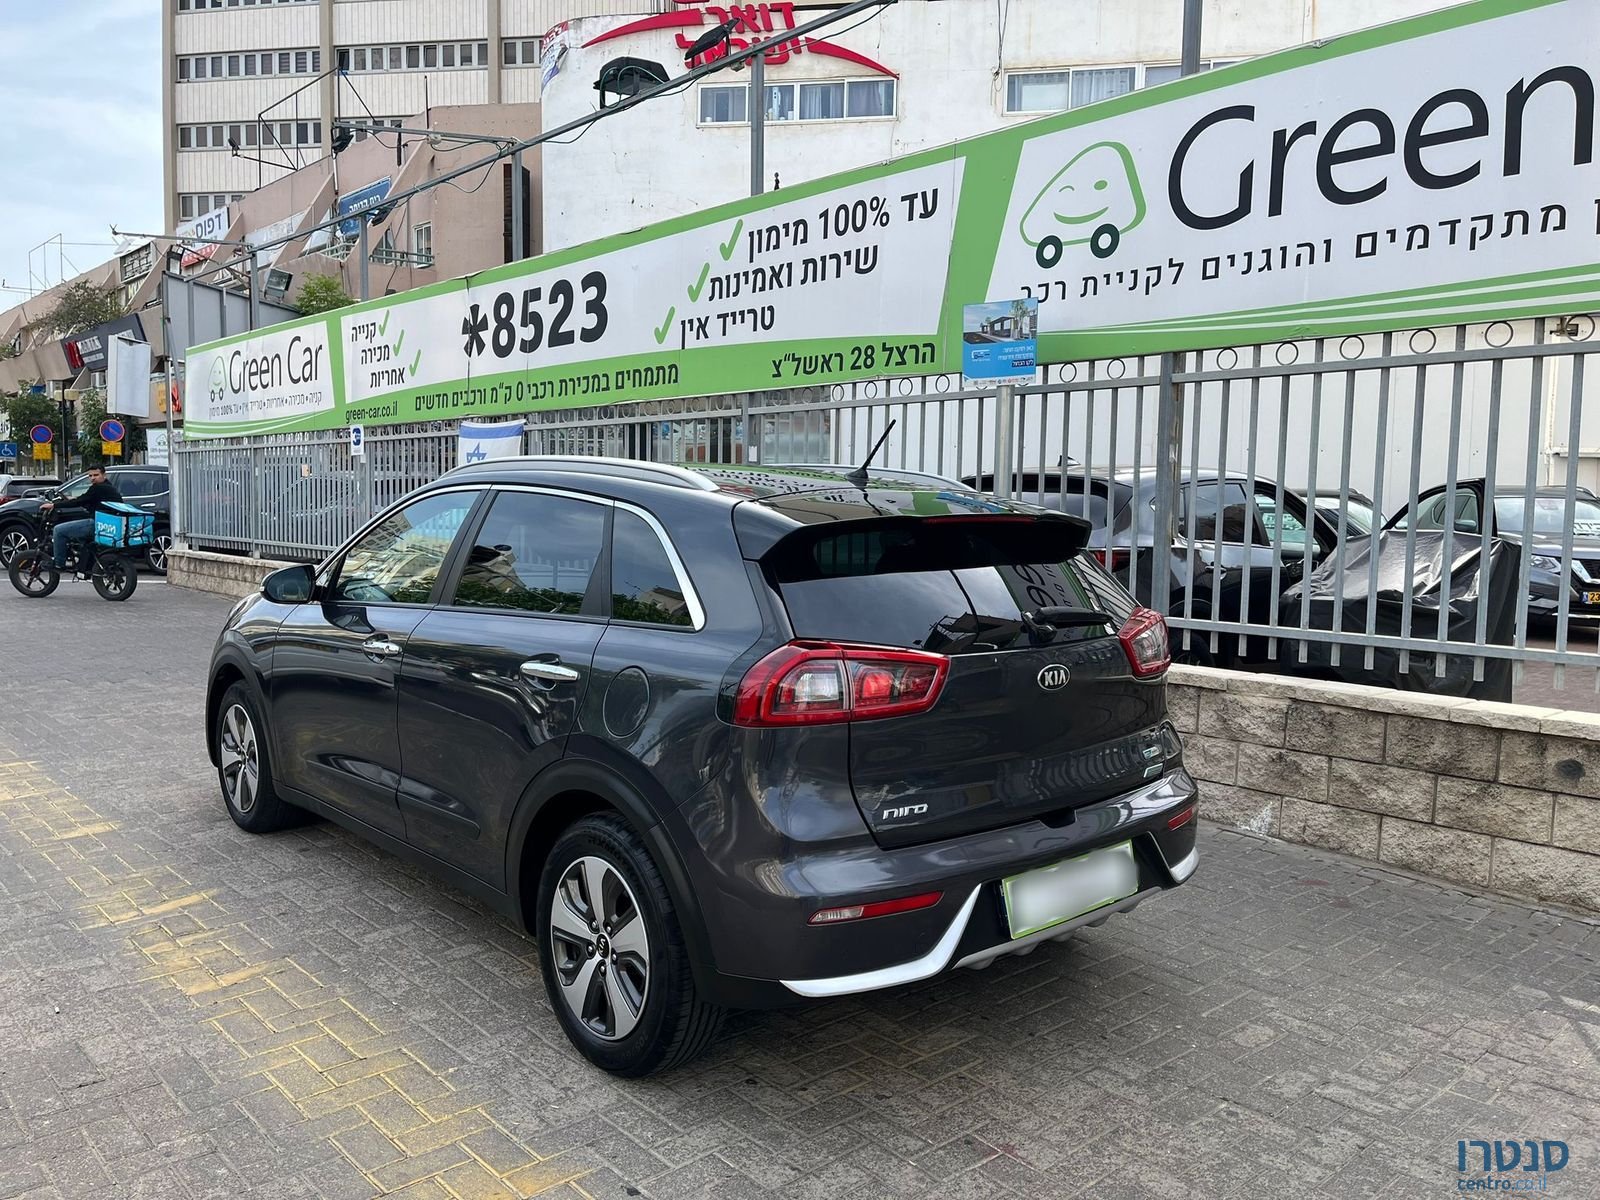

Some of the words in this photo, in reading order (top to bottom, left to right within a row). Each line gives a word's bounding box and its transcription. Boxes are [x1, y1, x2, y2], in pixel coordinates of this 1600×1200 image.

[705, 2, 795, 34] דואר
[1168, 65, 1595, 231] Green
[901, 188, 939, 221] עד
[195, 214, 222, 239] דפוס
[818, 196, 890, 240] 100%
[748, 218, 808, 263] מימון
[1355, 203, 1567, 259] מתקדמים
[800, 245, 879, 286] שירות
[1201, 237, 1332, 280] והוגנים
[708, 262, 792, 301] ואמינות
[1081, 258, 1184, 296] לקניית
[351, 322, 376, 343] קנייה
[680, 315, 709, 350] אין
[717, 305, 775, 336] טרייד
[229, 350, 282, 394] Green
[288, 336, 323, 385] Car
[361, 344, 390, 365] מכירה
[772, 352, 844, 378] ראשל"צ
[850, 345, 875, 370] 28
[882, 342, 935, 367] הרצל
[370, 367, 405, 388] אחריות
[558, 373, 610, 397] במכירת
[615, 363, 679, 389] מתמחים
[288, 394, 305, 406] מכירה
[308, 391, 322, 407] קניה
[415, 392, 449, 411] חדשים
[452, 389, 487, 407] ורכבים
[516, 380, 524, 399] 0
[527, 380, 554, 400] רכבי
[220, 404, 233, 416] 100%
[266, 396, 285, 410] אחריות
[345, 401, 398, 424] green-car.co.il
[1042, 668, 1067, 687] KIA
